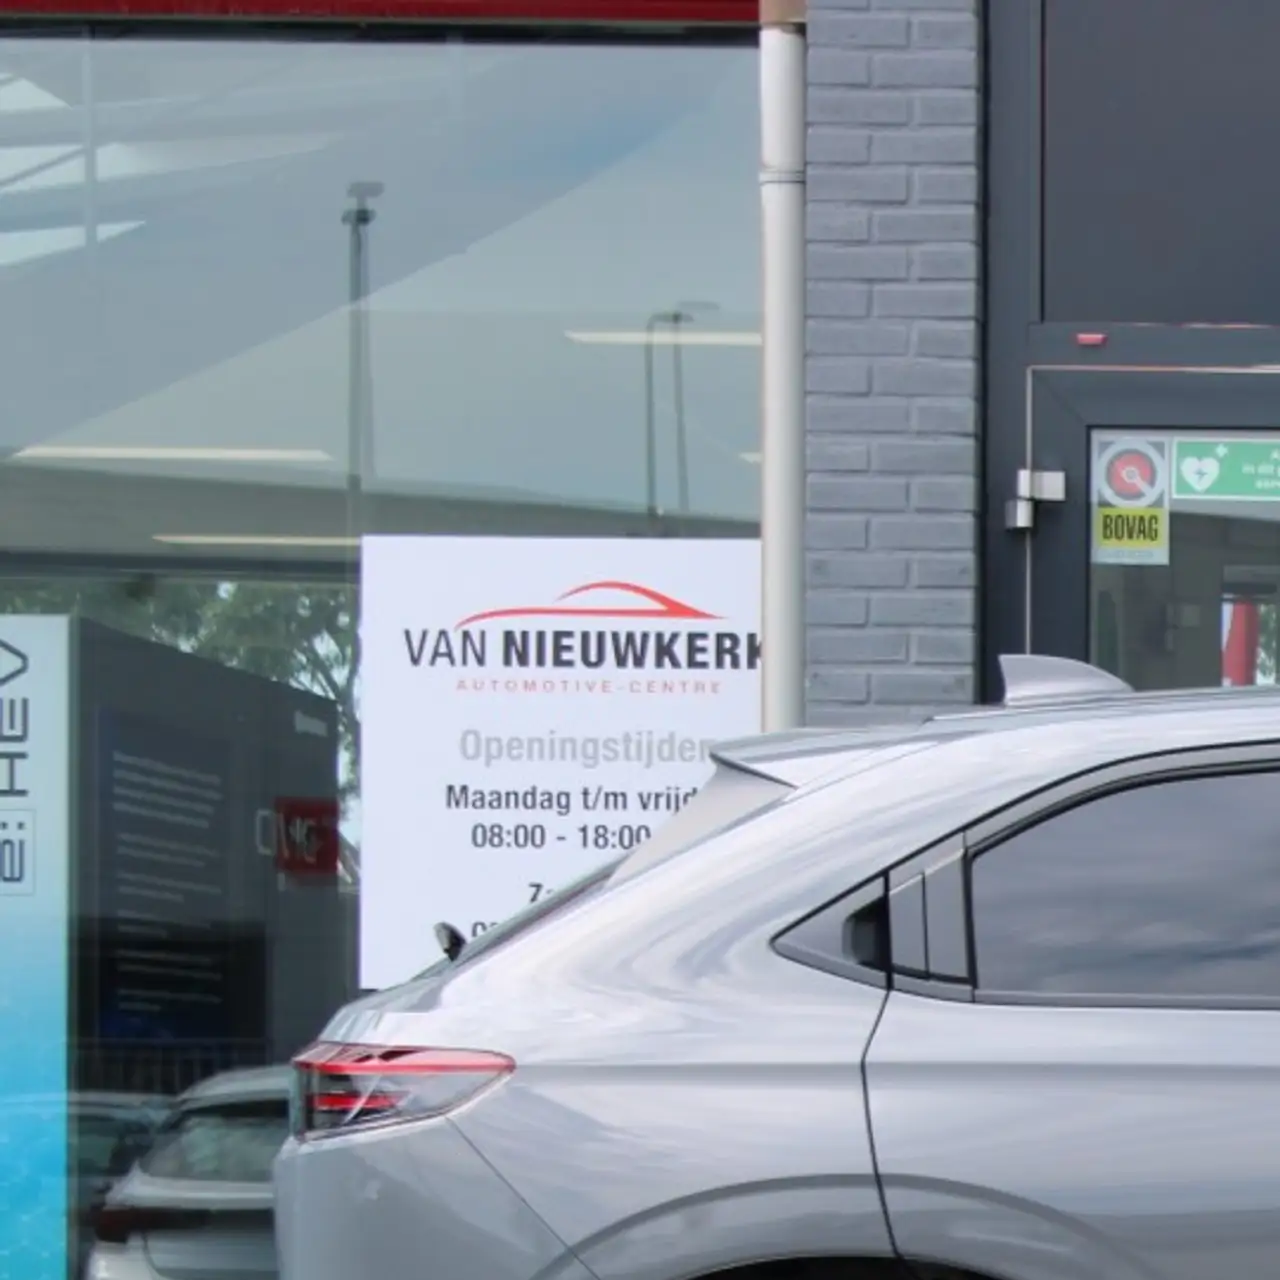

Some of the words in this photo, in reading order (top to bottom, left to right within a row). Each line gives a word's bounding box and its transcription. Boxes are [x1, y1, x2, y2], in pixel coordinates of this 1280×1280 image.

[1102, 513, 1160, 543] BOVAG
[404, 629, 486, 667] VAN
[456, 680, 721, 694] AUTOMOTIVE-CENTRE
[446, 784, 572, 817] Maandag
[581, 785, 629, 812] t/m
[471, 822, 546, 850] 08:00
